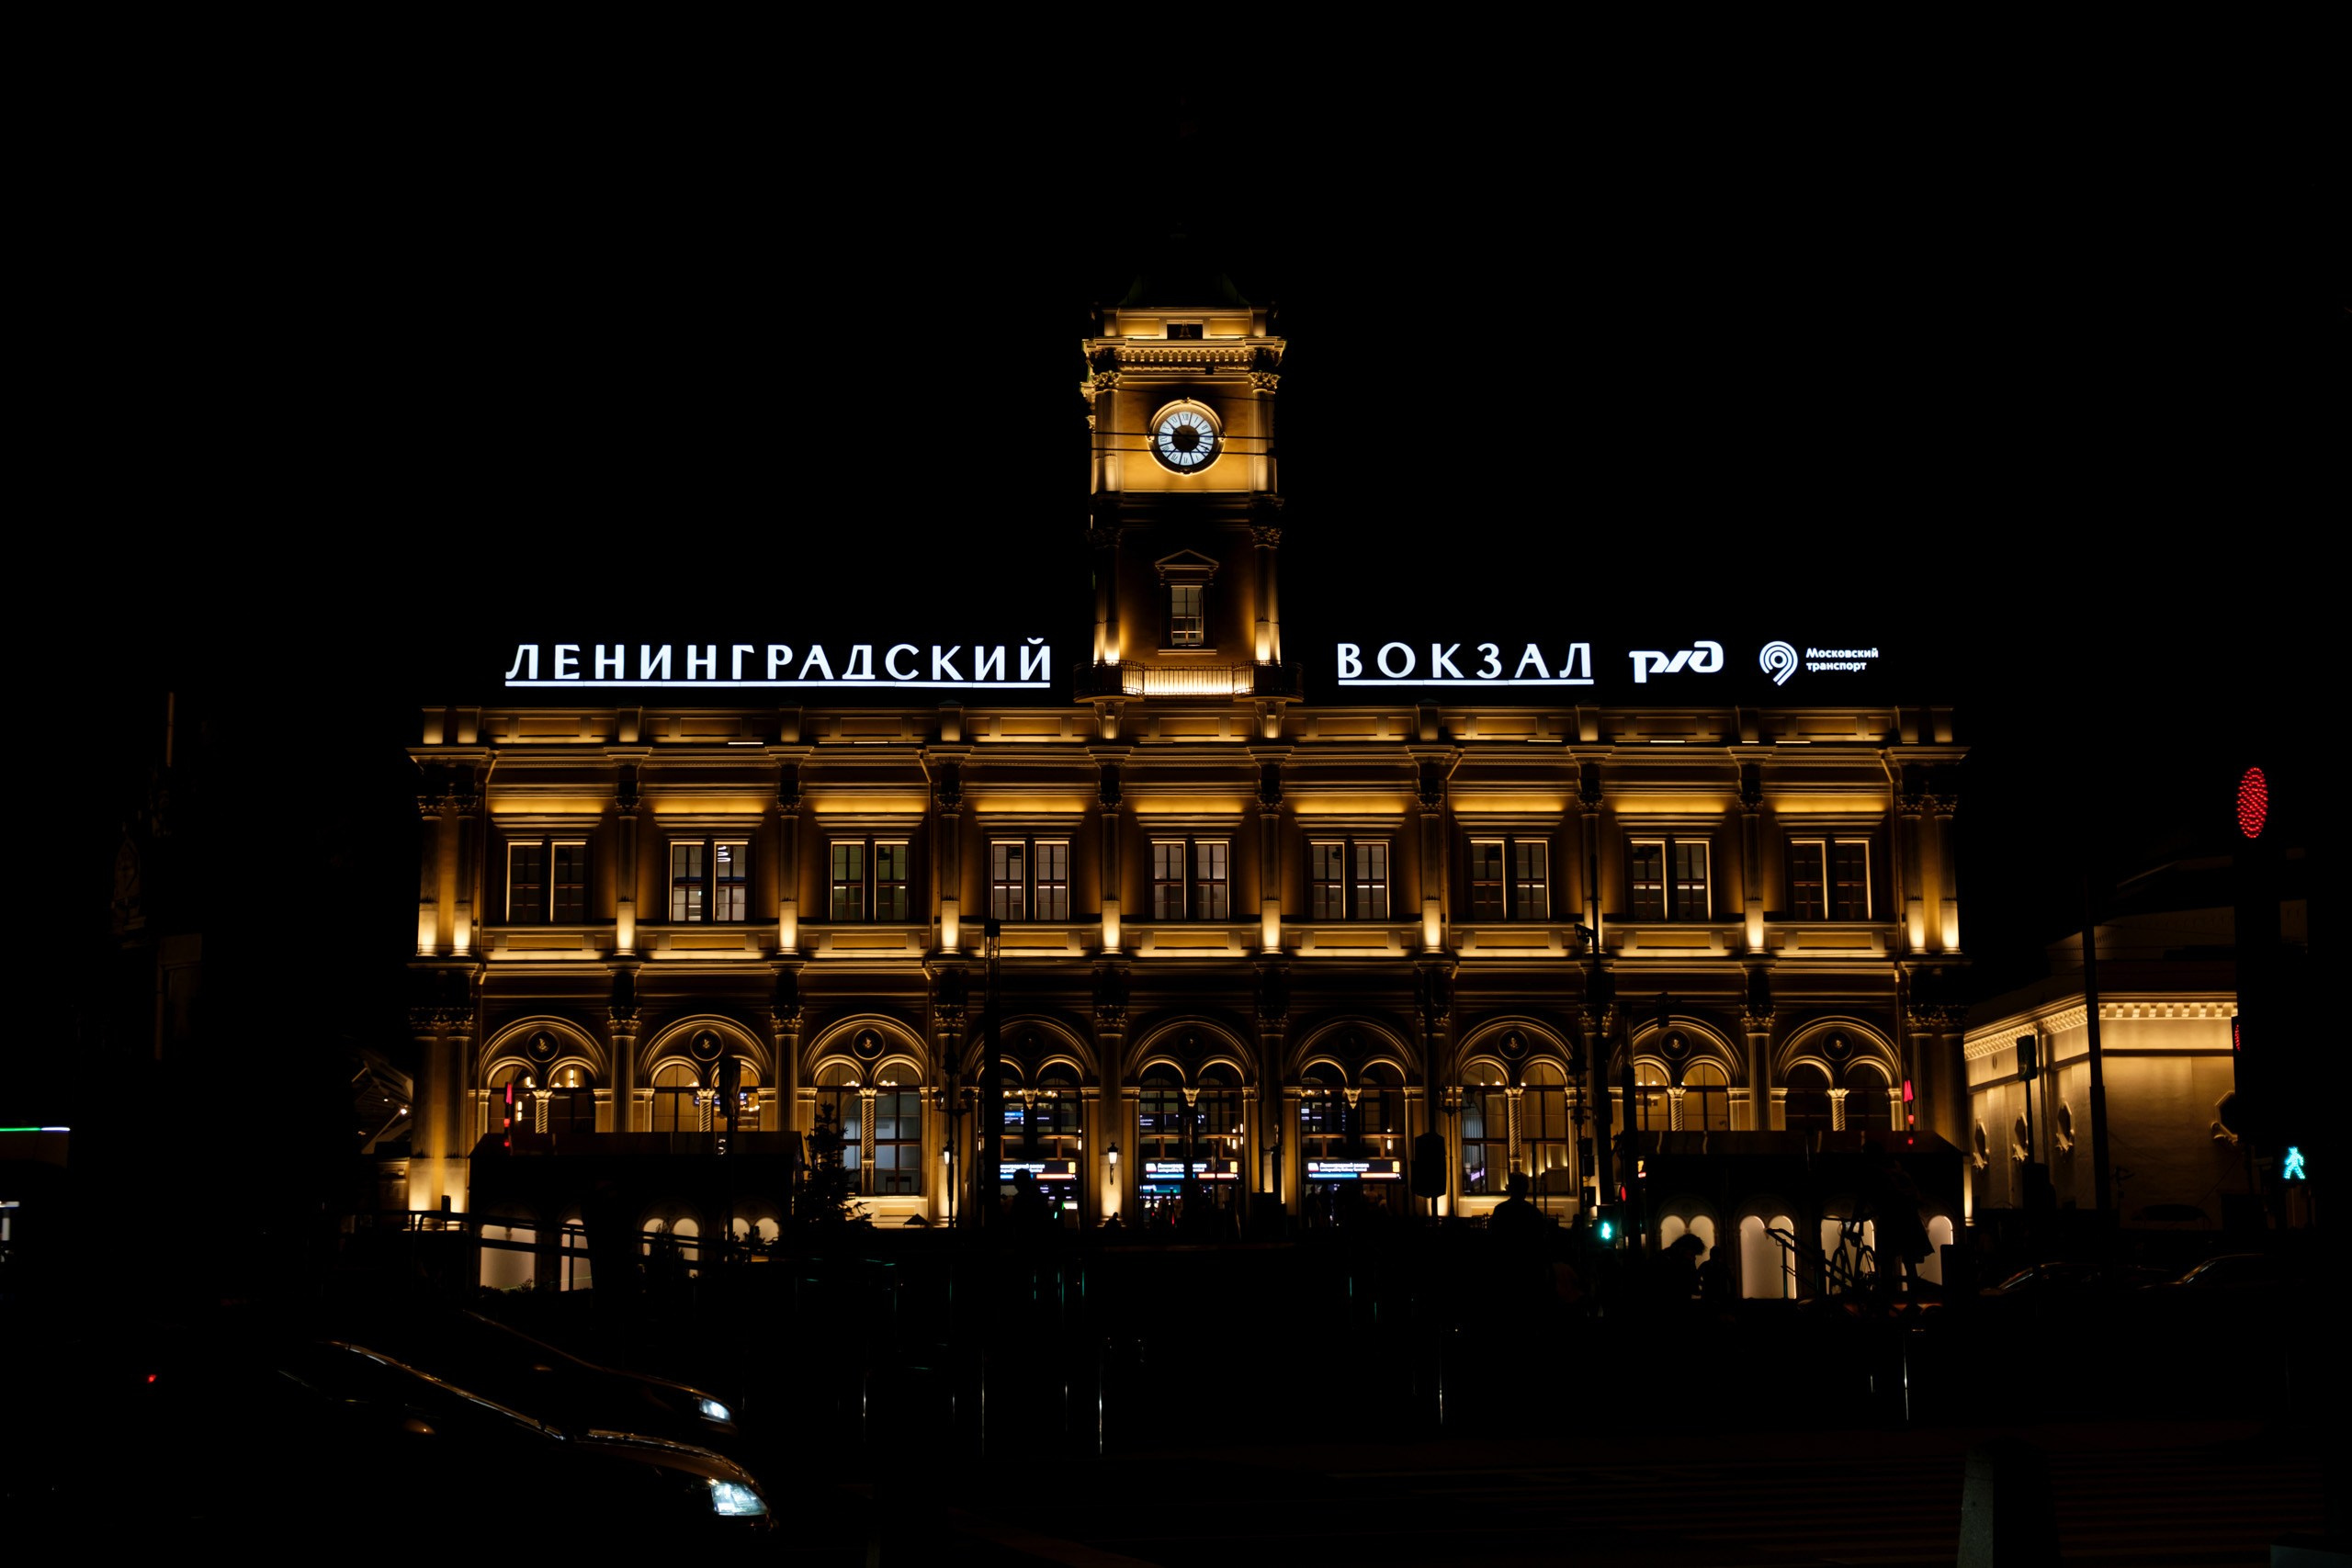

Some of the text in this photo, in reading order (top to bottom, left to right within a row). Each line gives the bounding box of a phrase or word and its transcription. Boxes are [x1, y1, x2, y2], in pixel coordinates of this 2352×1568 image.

[505, 637, 1592, 680] ЛЕНИНГРАДСКИЙ ВОКЗАЛ
[1805, 647, 1879, 659] Московский
[1805, 661, 1867, 673] транспорт
